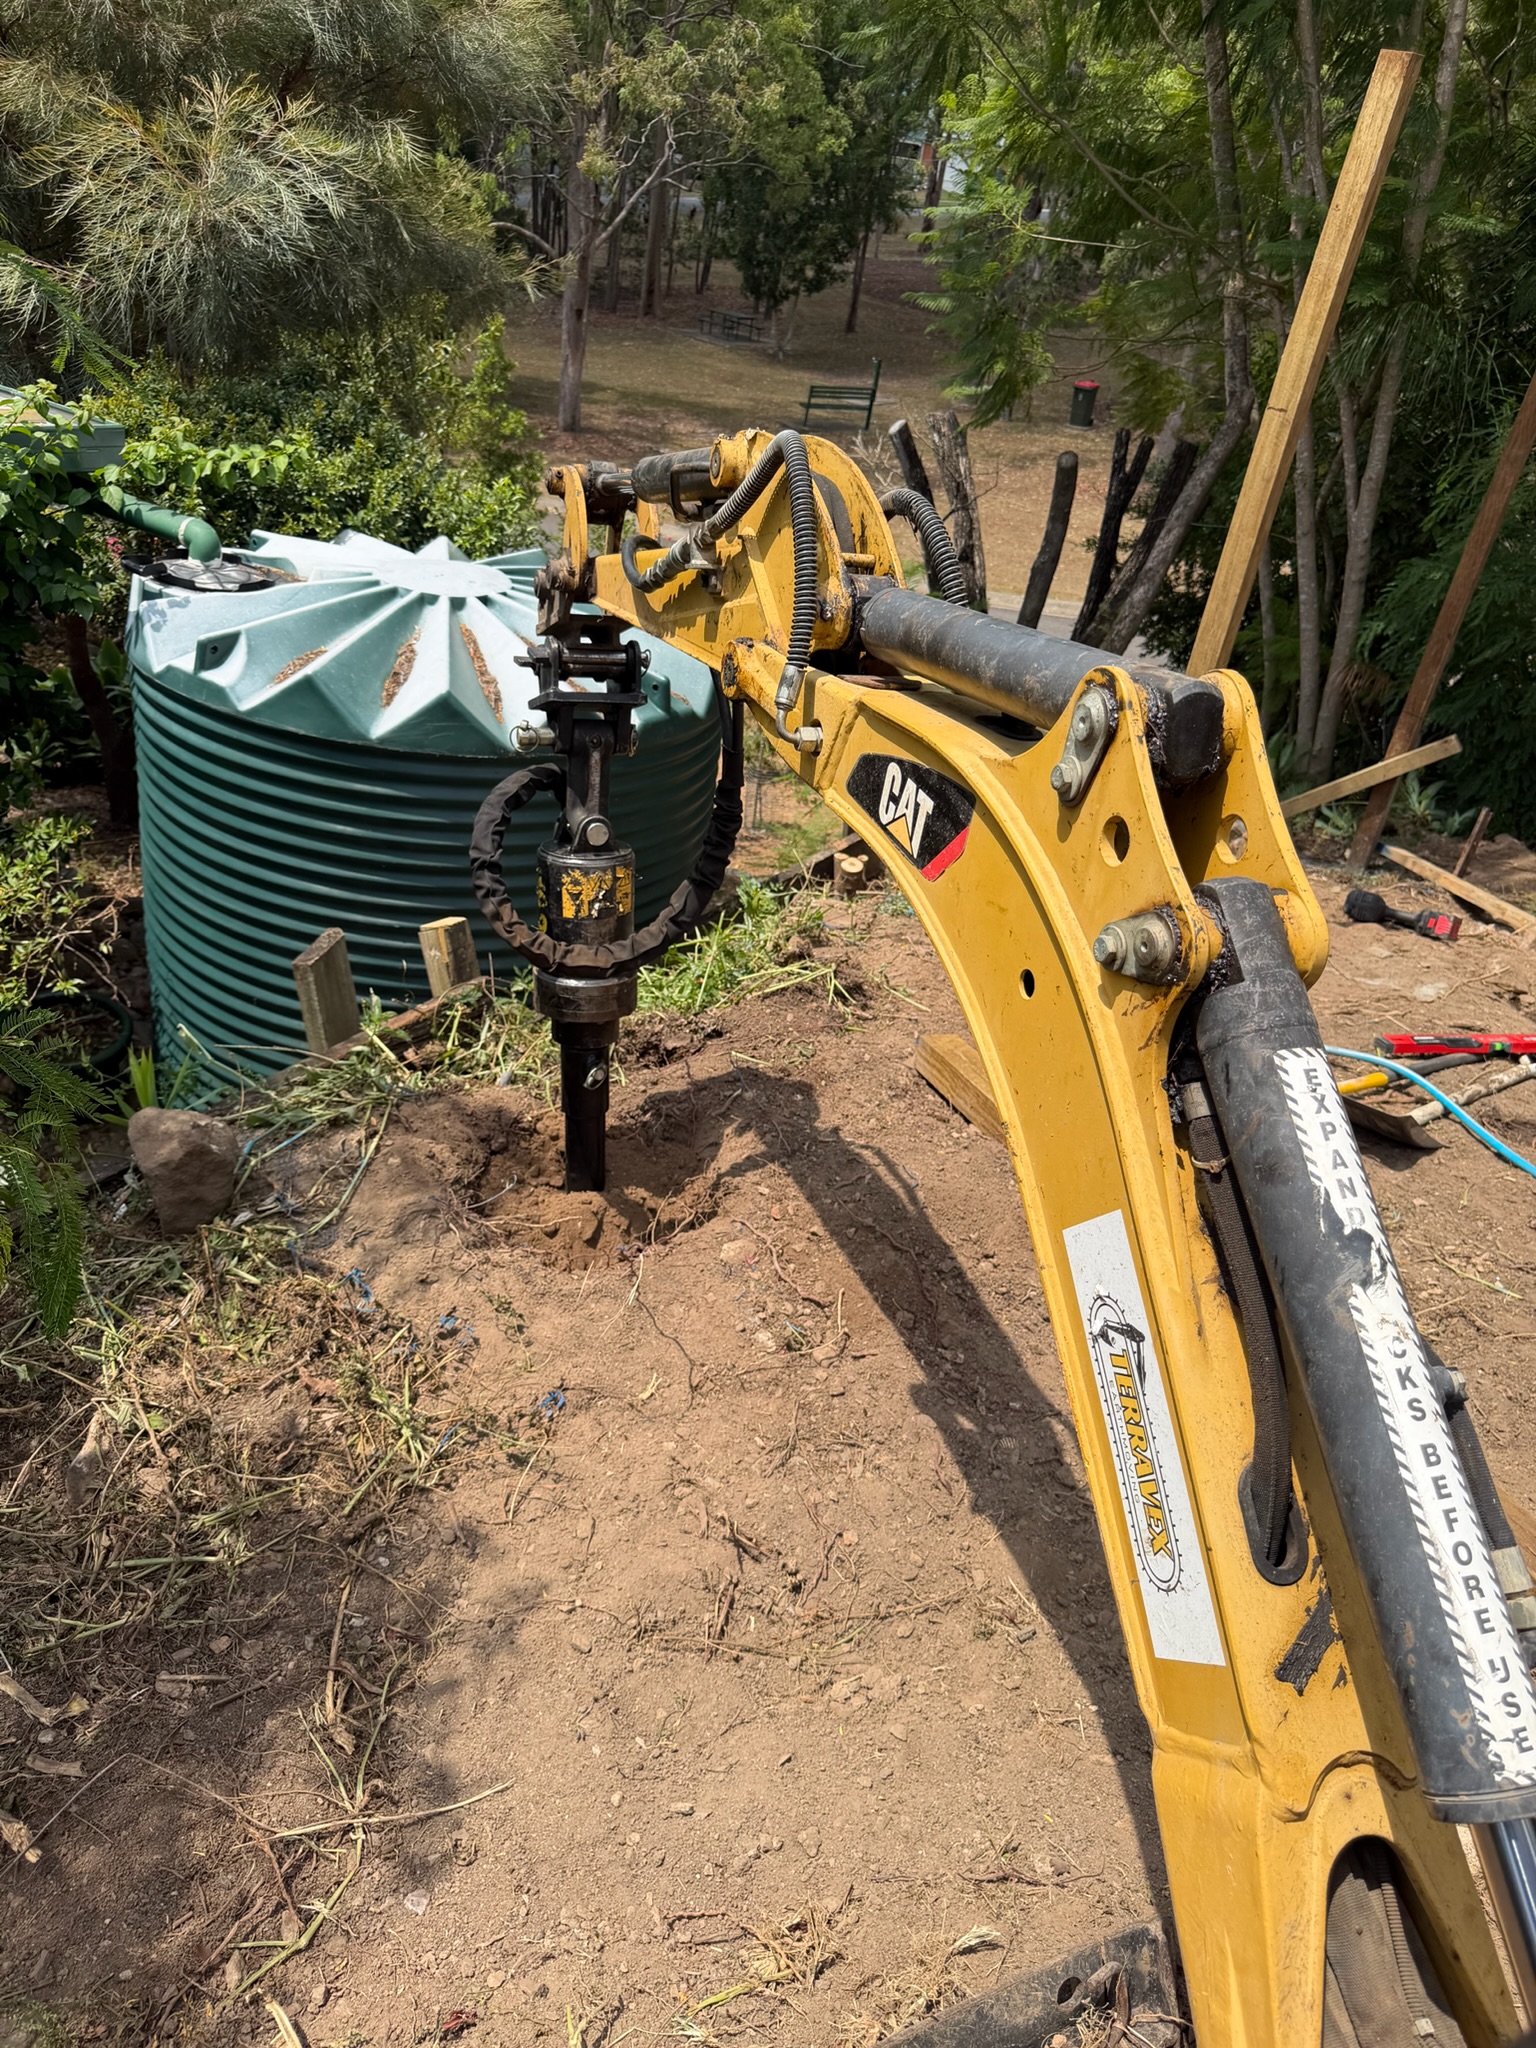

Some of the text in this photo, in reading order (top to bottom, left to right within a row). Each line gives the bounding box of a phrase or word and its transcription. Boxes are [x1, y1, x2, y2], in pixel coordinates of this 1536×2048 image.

[879, 762, 934, 859] CAT
[1109, 1348, 1175, 1563] TERRAVEX
[1303, 1068, 1366, 1228] EXPAND
[1420, 1442, 1496, 1635] BEFORE
[1487, 1656, 1534, 1754] USE
